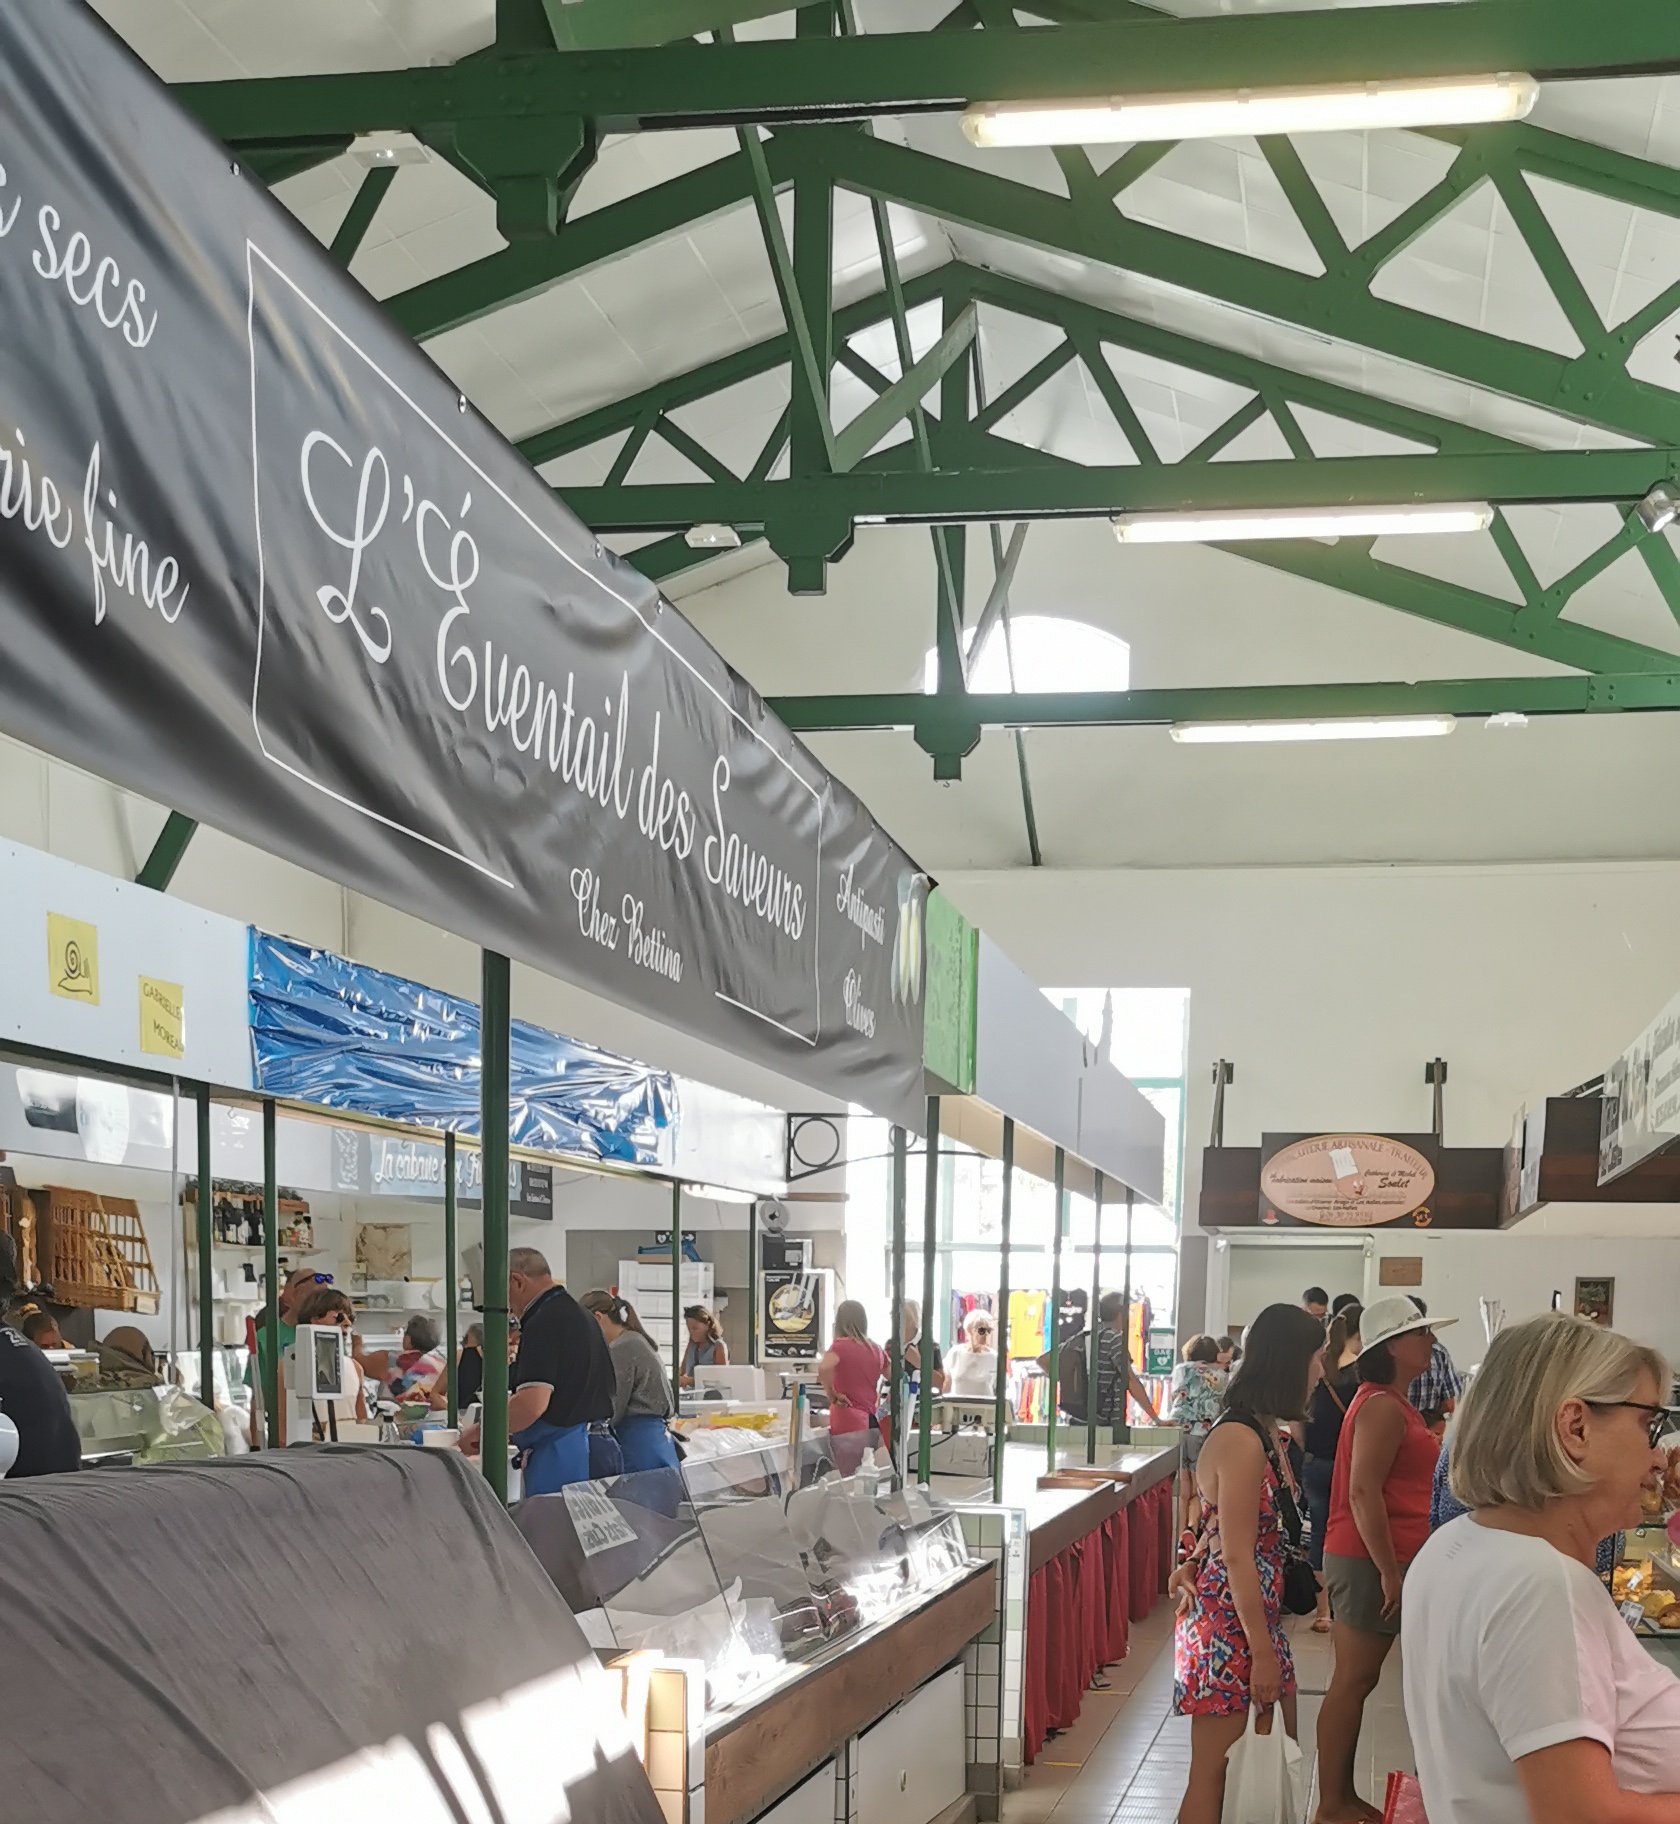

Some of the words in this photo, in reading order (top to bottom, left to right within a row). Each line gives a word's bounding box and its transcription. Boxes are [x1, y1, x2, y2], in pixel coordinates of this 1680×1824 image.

[32, 204, 158, 348] secs
[84, 440, 190, 626] fine
[638, 712, 696, 860] des
[704, 755, 807, 940] Saveurs
[570, 867, 620, 950] Chez
[622, 893, 683, 983] Bettina
[836, 863, 886, 951] Antipasti
[843, 967, 877, 1039] Olives
[374, 1139, 393, 1185] La
